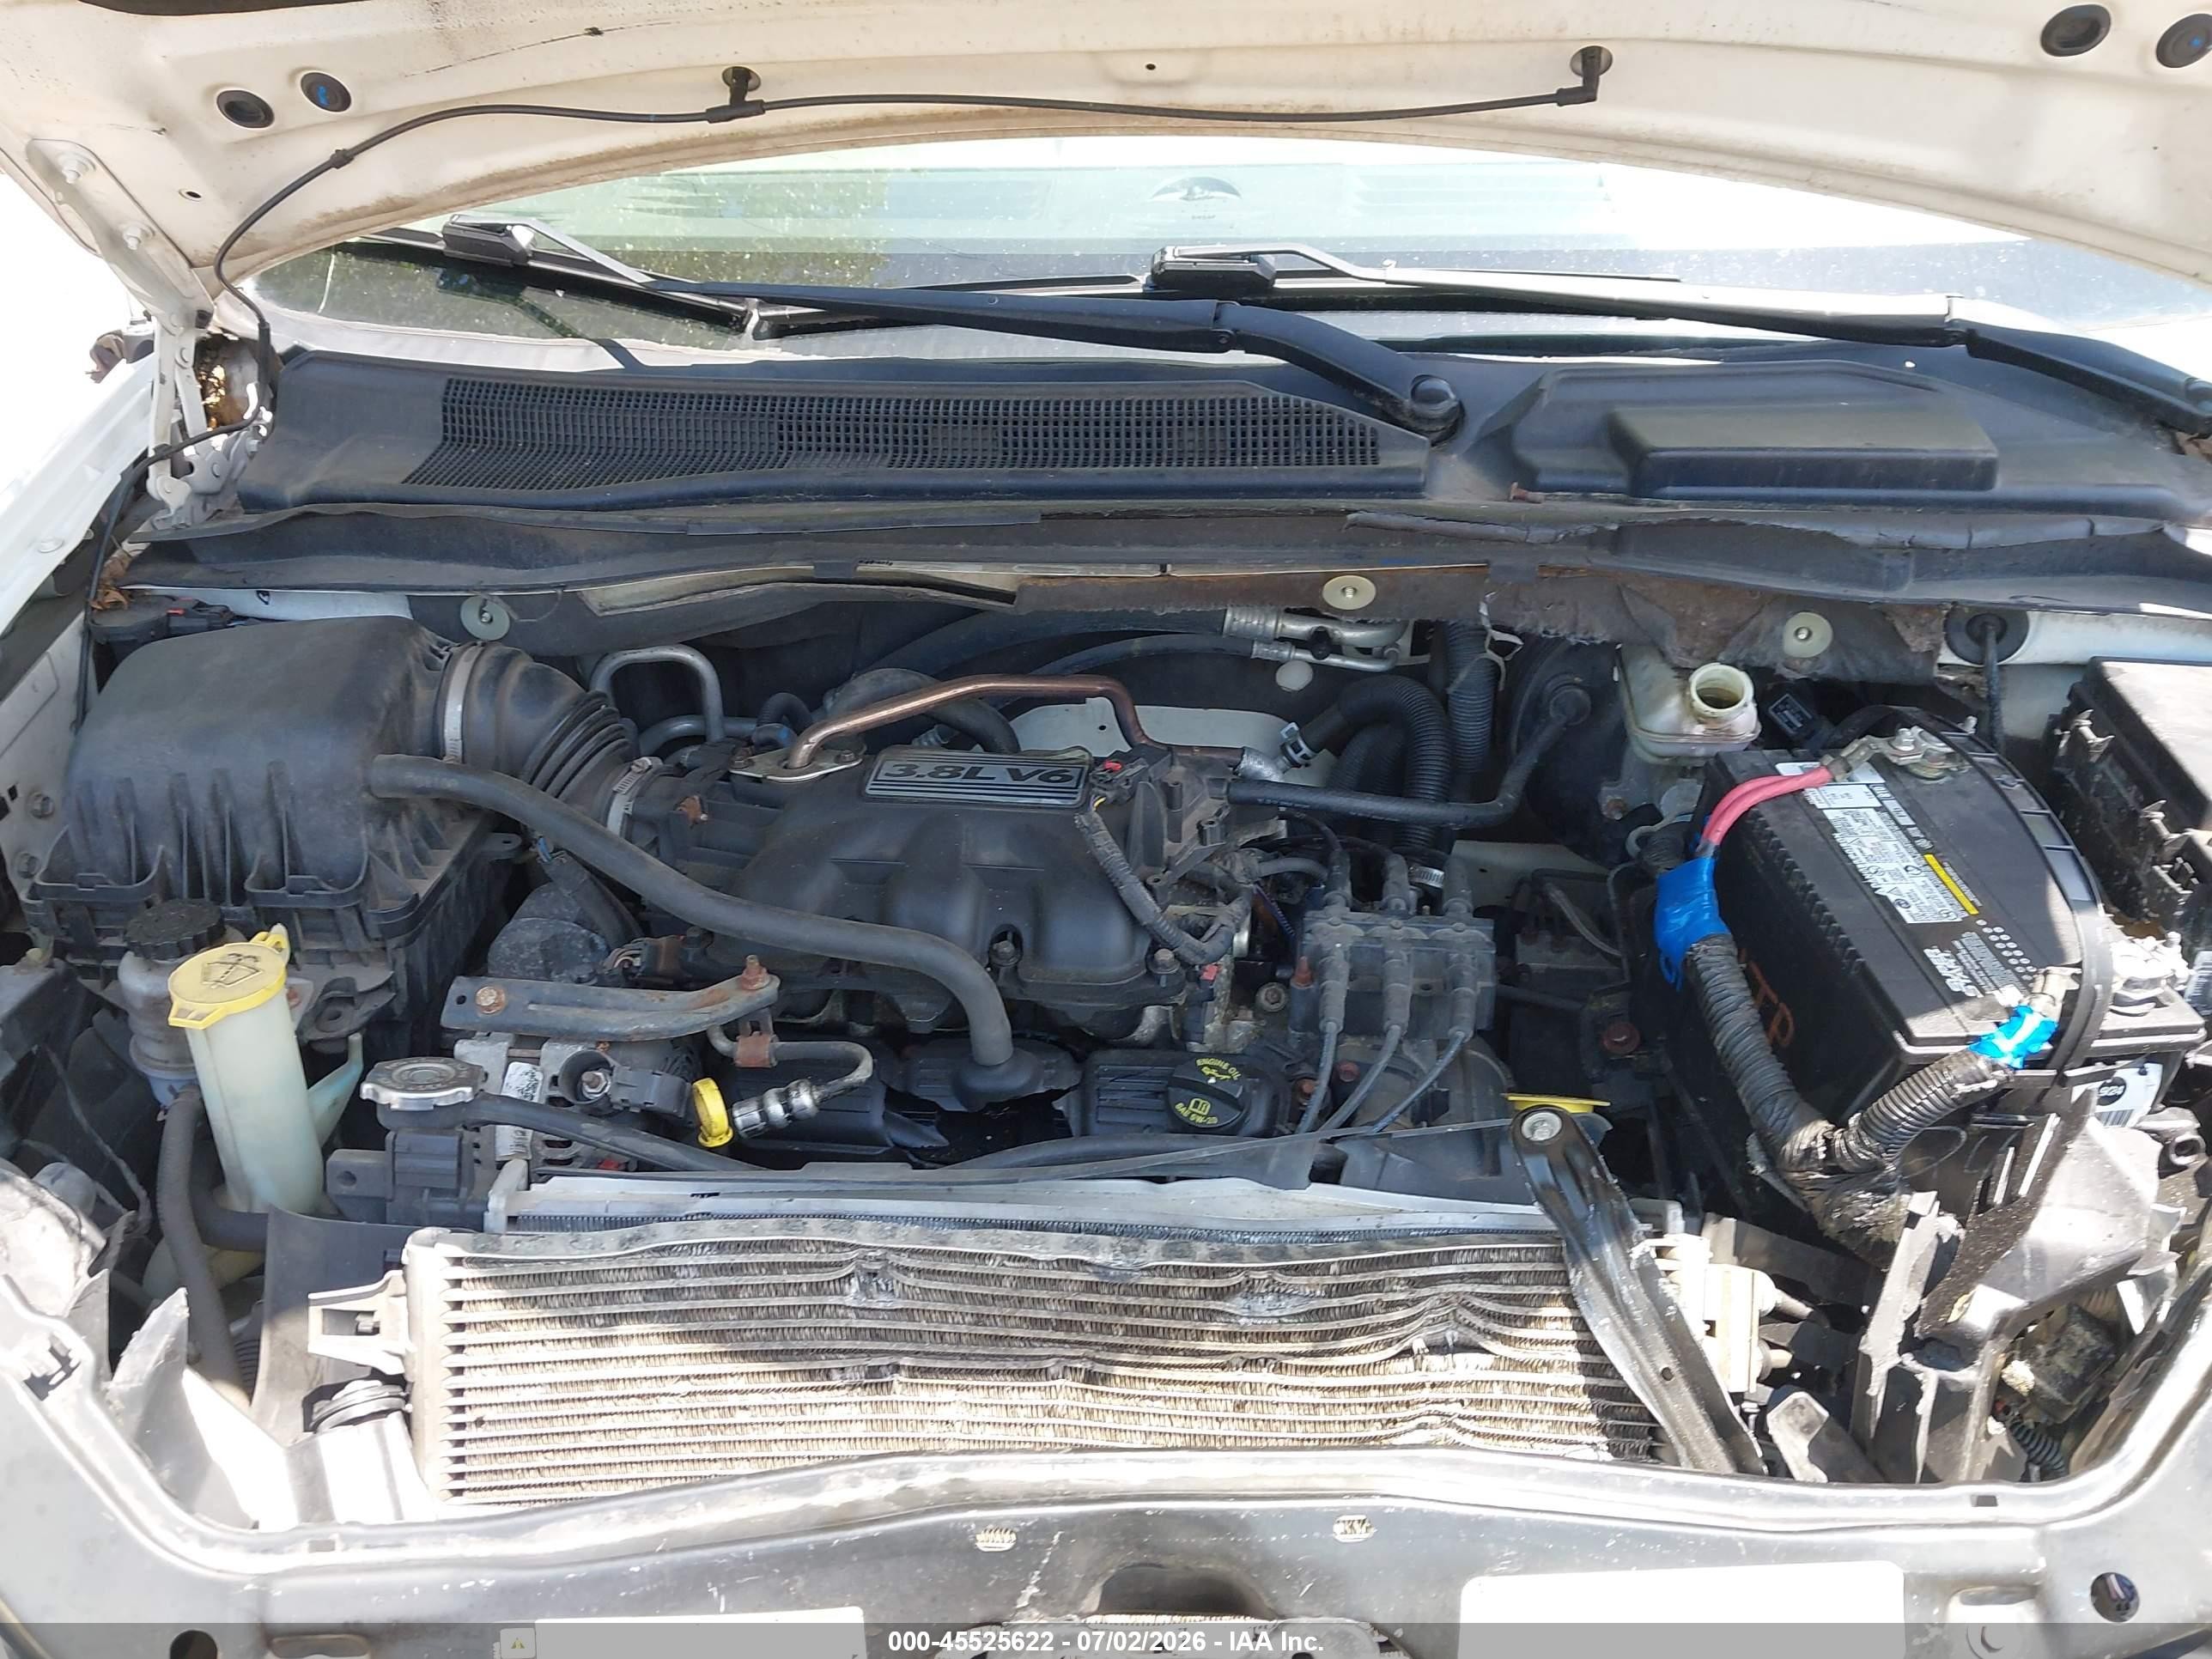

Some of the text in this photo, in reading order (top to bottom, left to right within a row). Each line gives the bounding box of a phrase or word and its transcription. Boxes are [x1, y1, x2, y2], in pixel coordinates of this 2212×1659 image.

[884, 763, 1074, 784] 3.8L V6
[1195, 1057, 1242, 1080] ENGINE OIL
[1175, 1102, 1190, 1117] SAE
